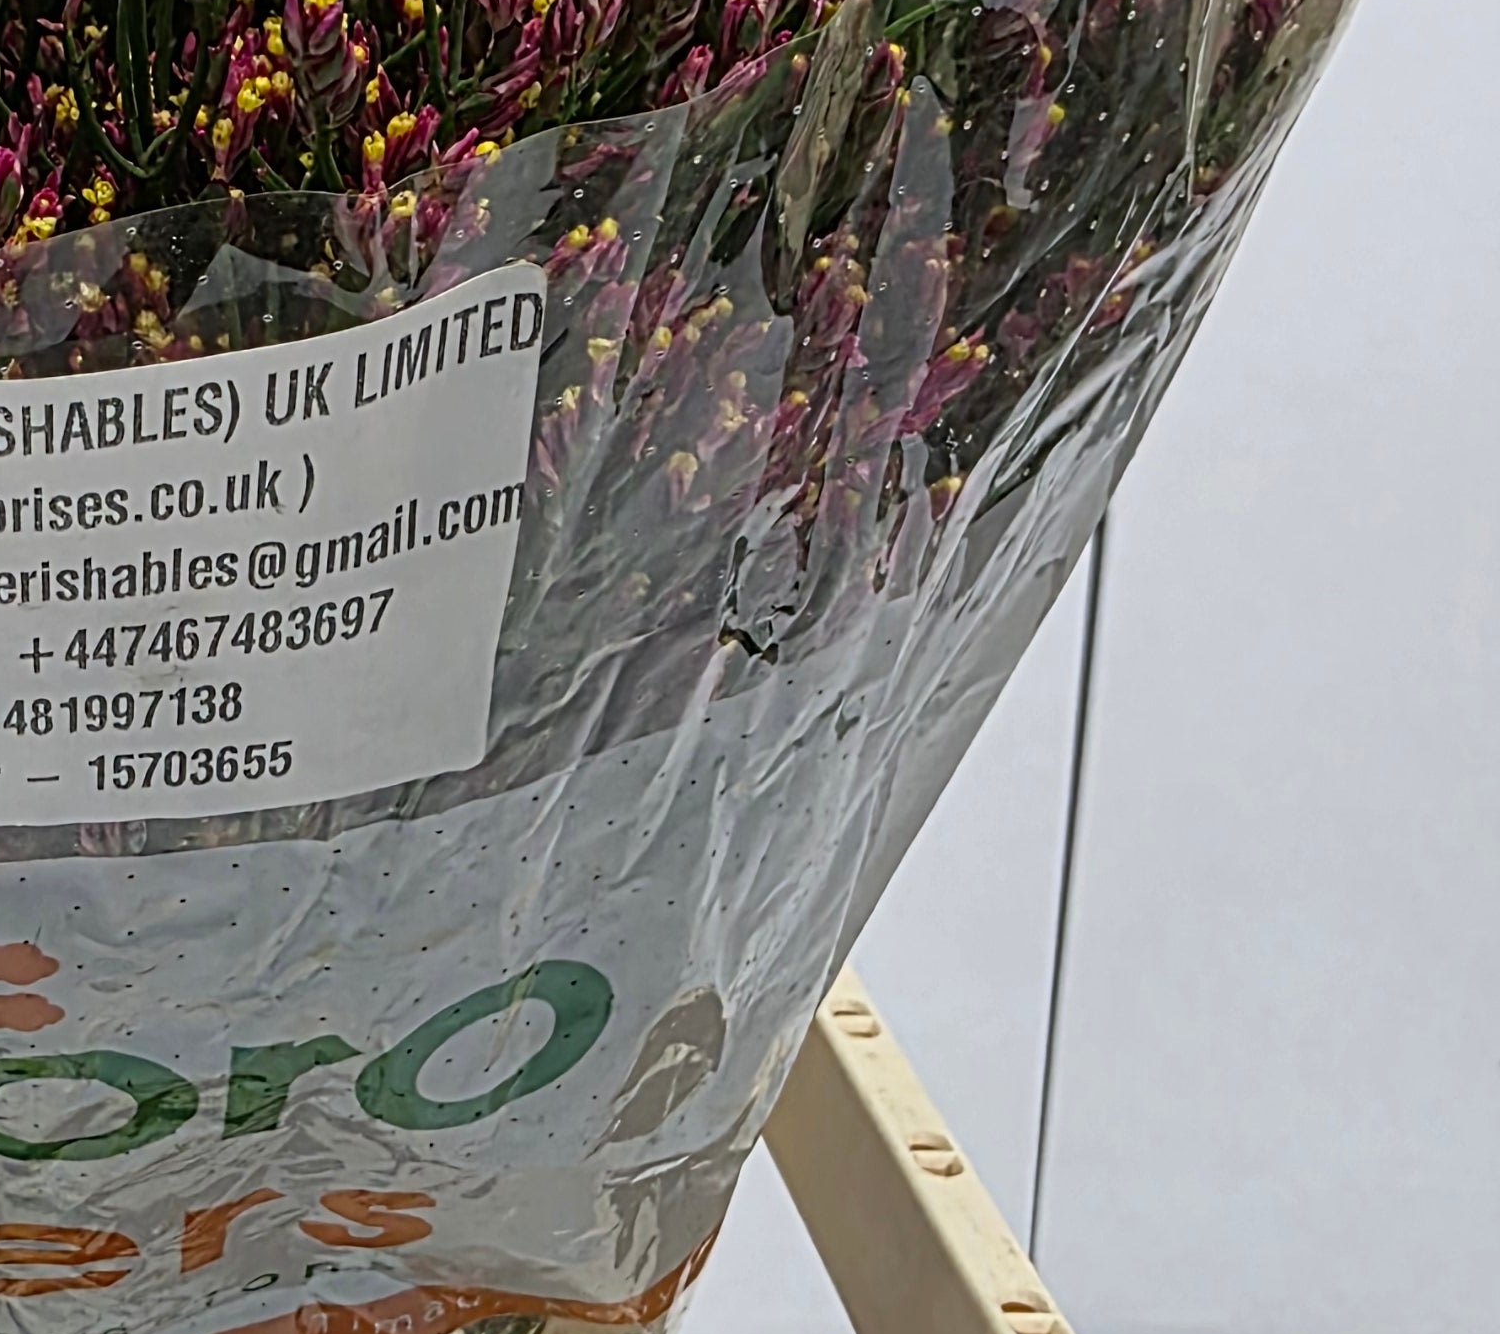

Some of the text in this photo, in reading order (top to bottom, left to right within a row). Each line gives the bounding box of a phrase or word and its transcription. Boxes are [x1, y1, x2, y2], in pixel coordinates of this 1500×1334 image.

[266, 362, 333, 426] UK
[355, 293, 542, 408] LIMITED
[19, 588, 394, 674] +447467483697
[3, 682, 242, 735] 481997138
[88, 740, 292, 790] 15703655
